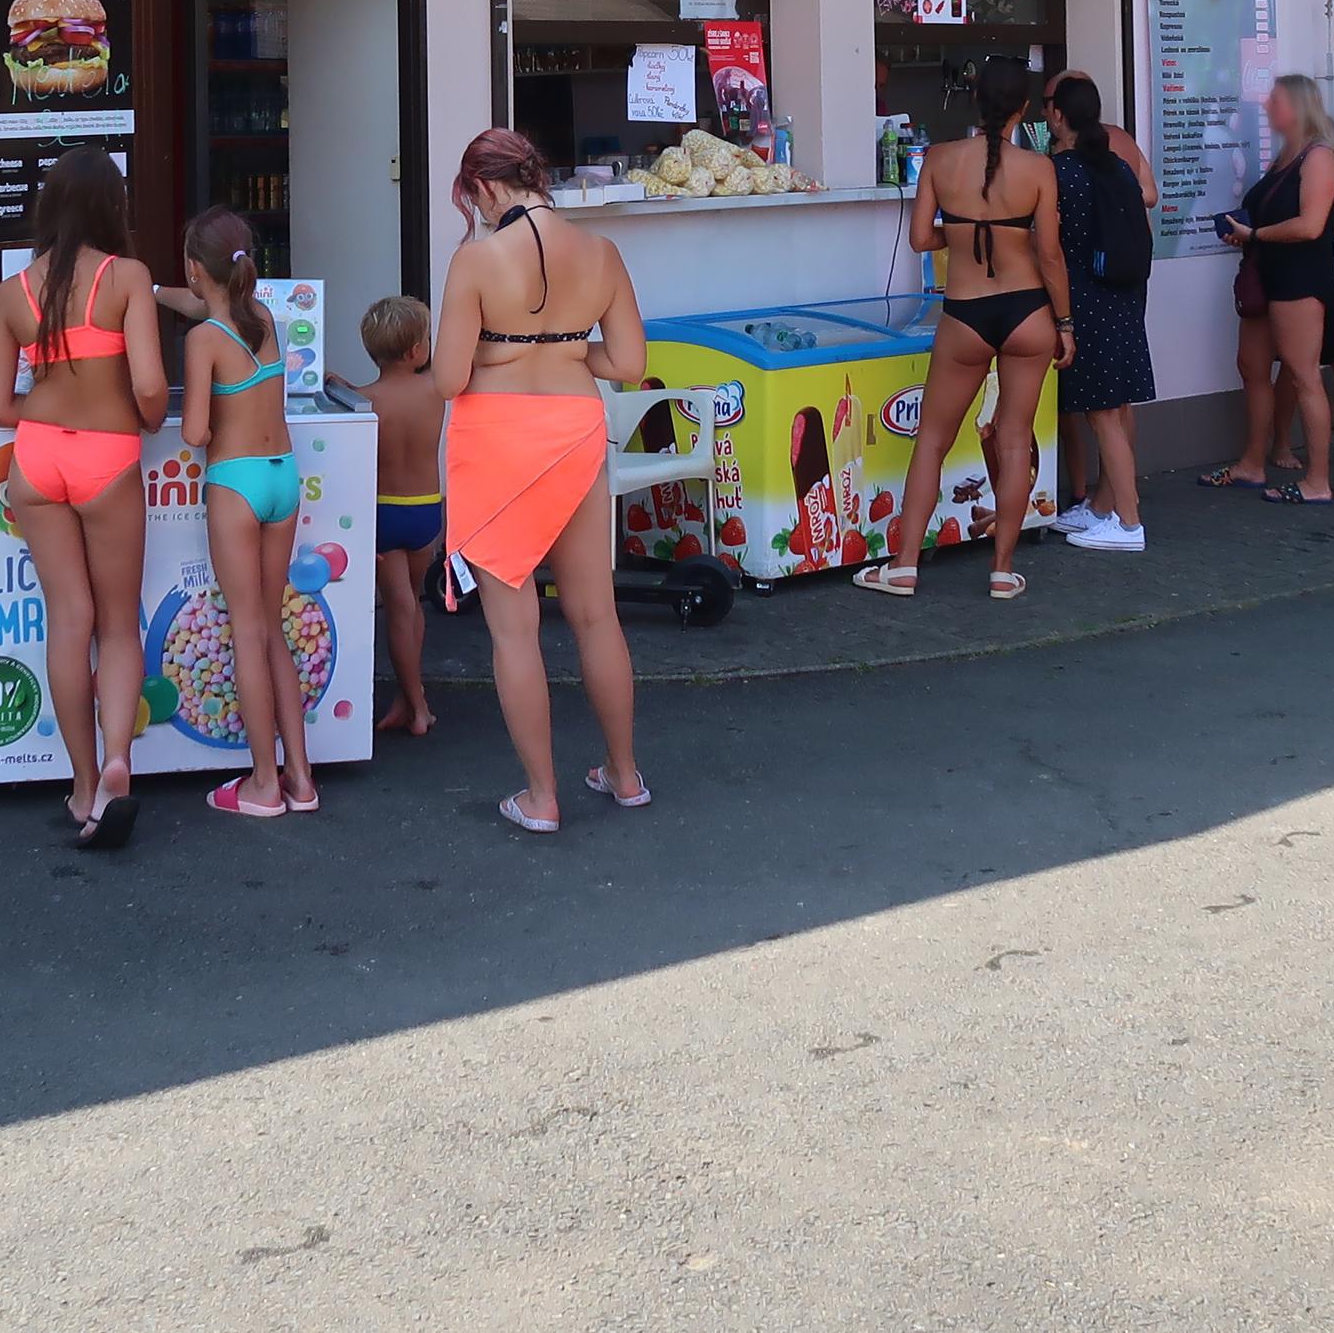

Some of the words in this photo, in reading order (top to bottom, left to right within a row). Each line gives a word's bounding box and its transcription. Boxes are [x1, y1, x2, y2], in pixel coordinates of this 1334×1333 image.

[148, 450, 203, 507] ini
[172, 512, 190, 521] ICE
[181, 562, 208, 576] FRESH
[183, 572, 210, 589] Milk
